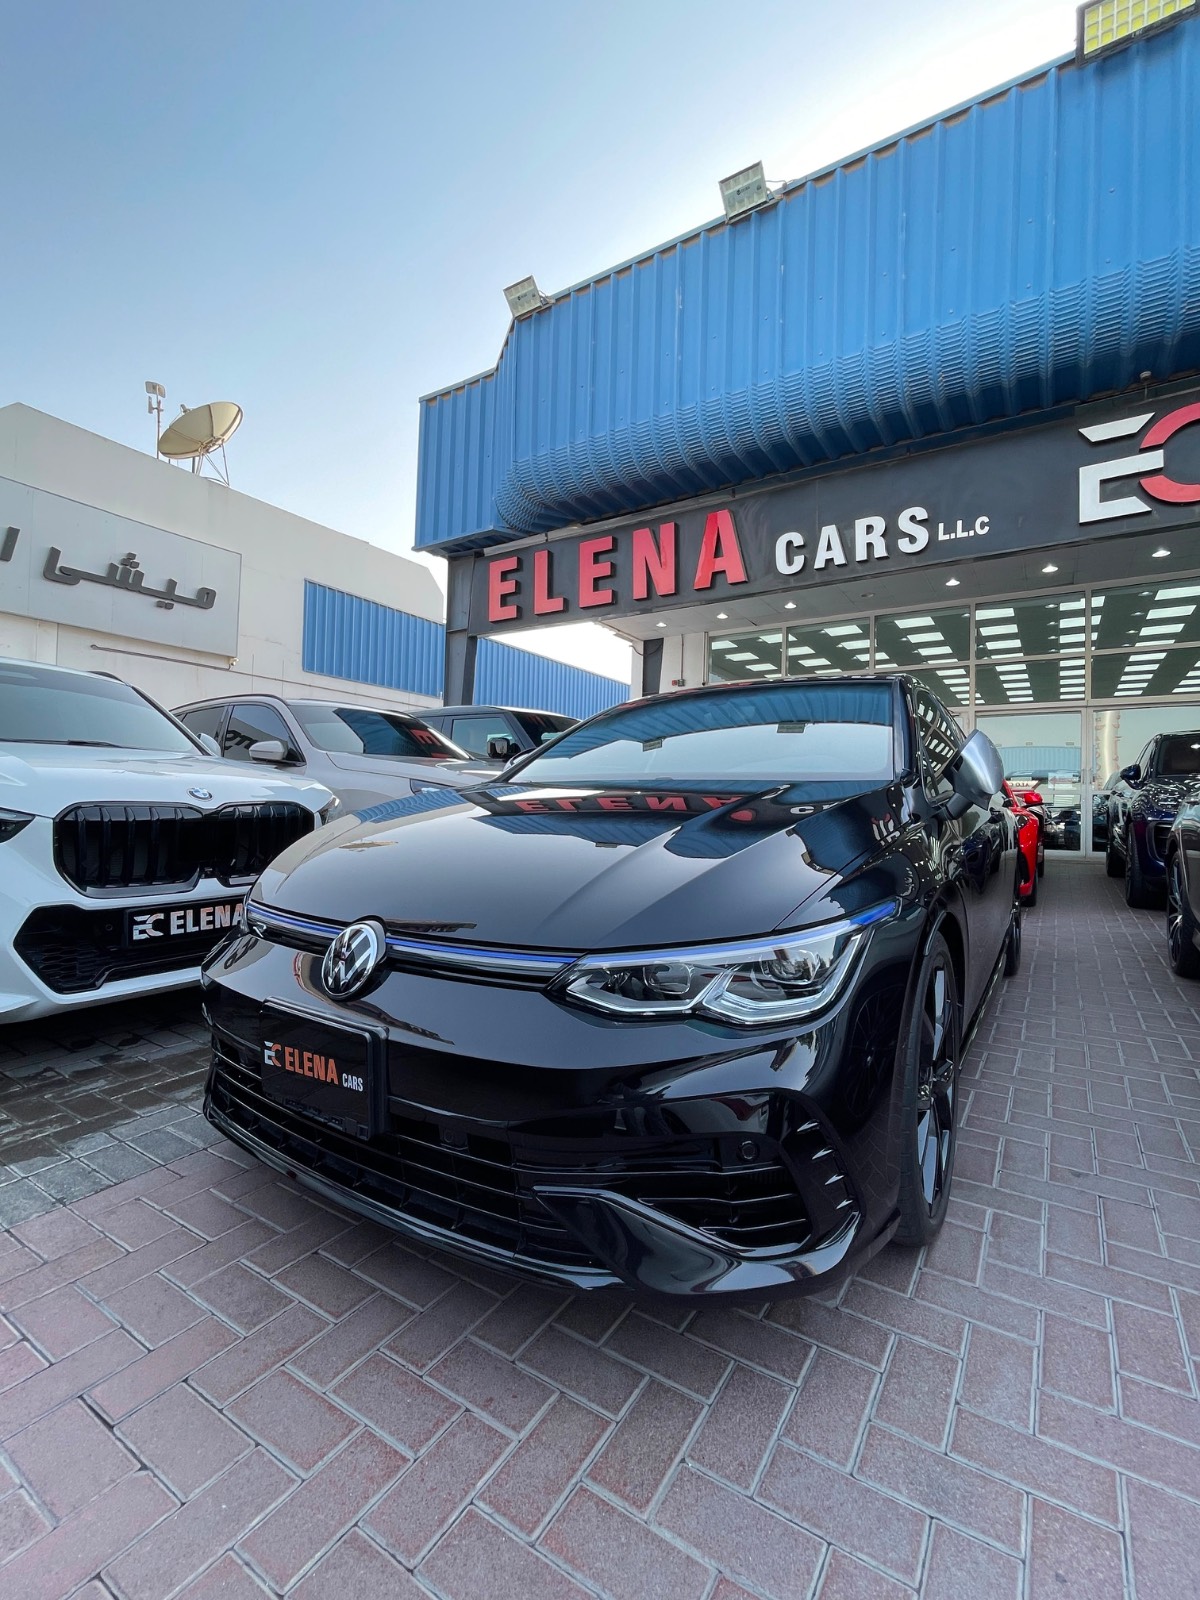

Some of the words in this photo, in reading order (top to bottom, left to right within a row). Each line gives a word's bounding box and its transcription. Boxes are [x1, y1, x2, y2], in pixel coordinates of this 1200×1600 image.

[488, 509, 748, 622] ELENA
[775, 506, 930, 576] CARS
[938, 516, 990, 541] L.L.C
[170, 903, 244, 935] ELENA
[285, 1046, 339, 1085] ELENA
[342, 1073, 363, 1092] CARS
